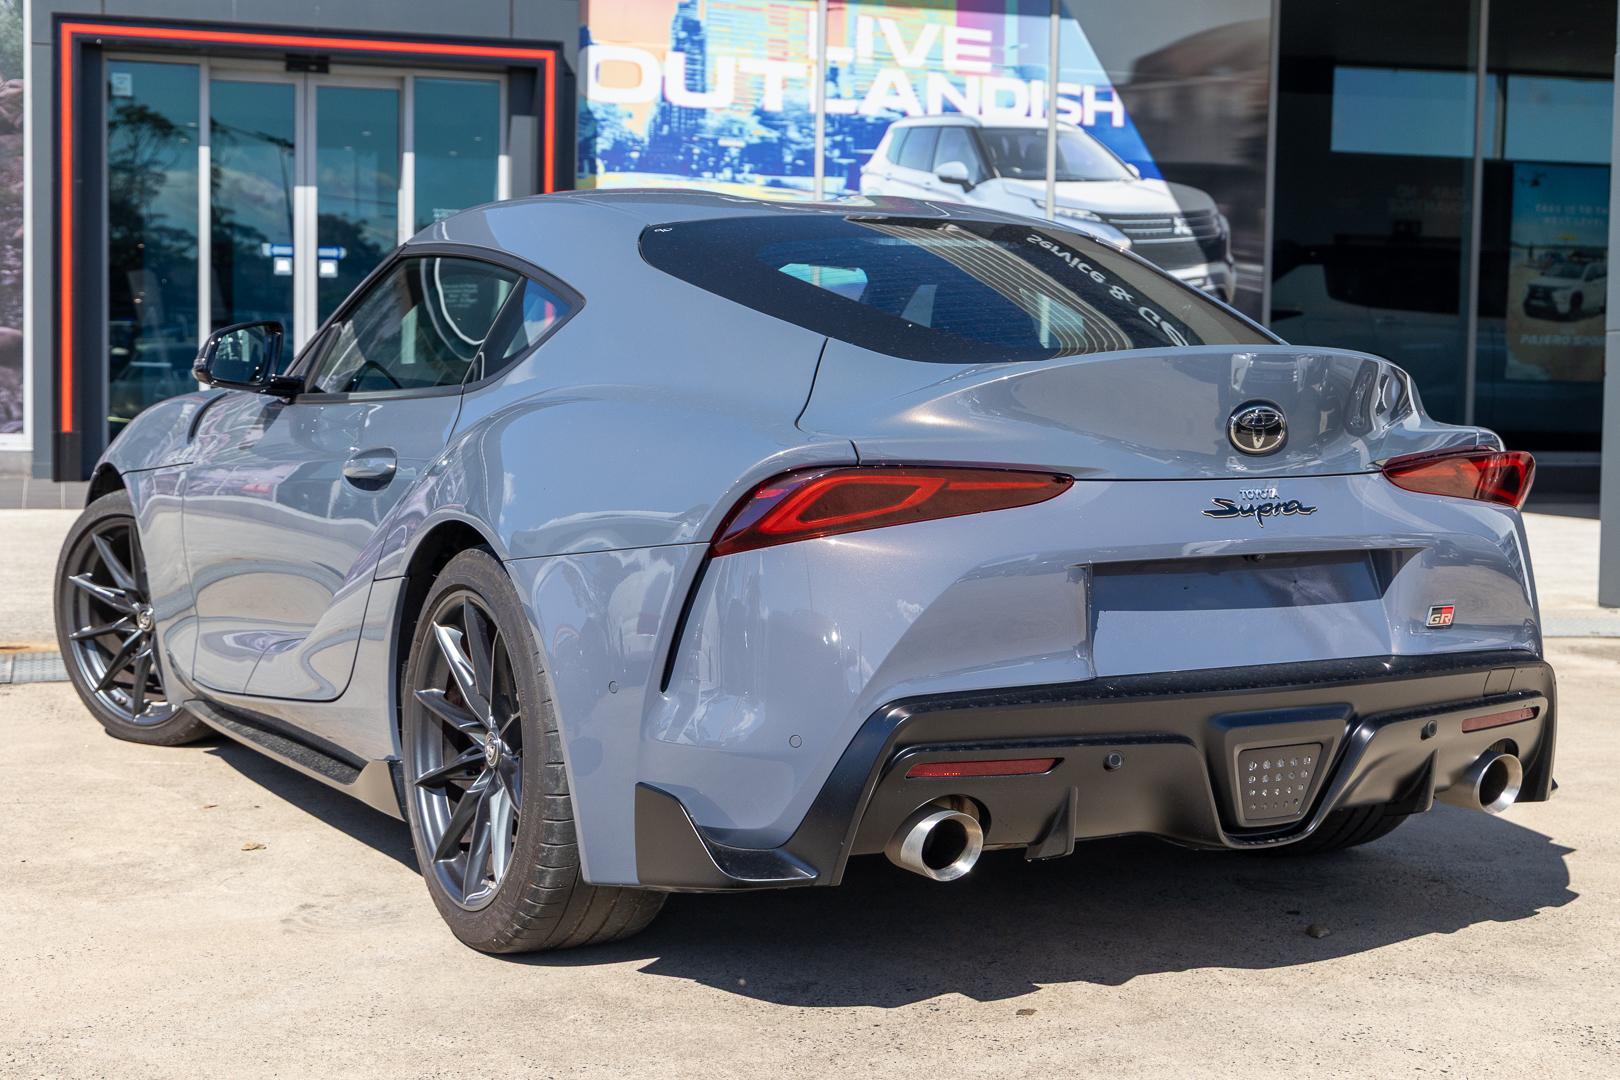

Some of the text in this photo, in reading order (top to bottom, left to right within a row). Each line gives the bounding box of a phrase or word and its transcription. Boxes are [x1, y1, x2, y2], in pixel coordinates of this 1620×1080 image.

[807, 9, 993, 73] LIVE
[580, 44, 1126, 128] OUTLANDISH
[1239, 487, 1280, 500] TOYOTA
[1201, 497, 1318, 528] Supra
[1429, 613, 1452, 625] GR
